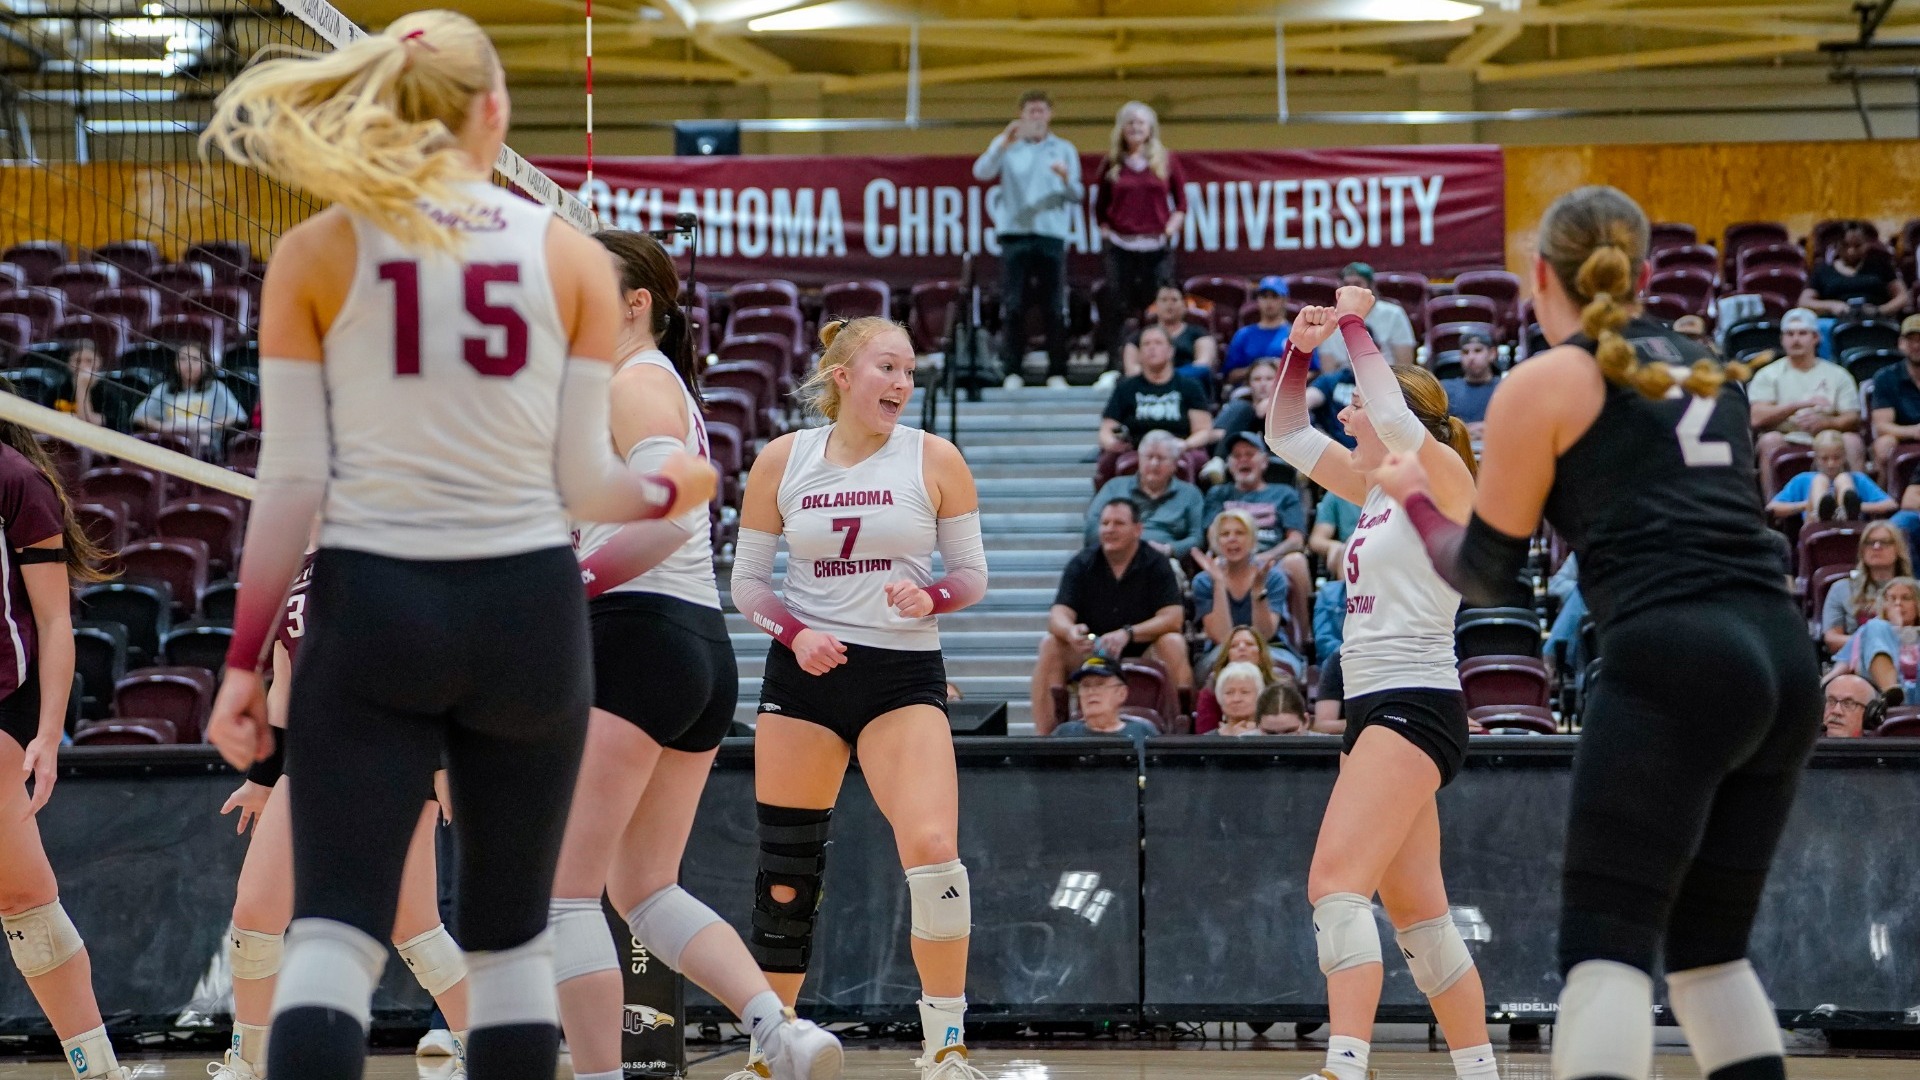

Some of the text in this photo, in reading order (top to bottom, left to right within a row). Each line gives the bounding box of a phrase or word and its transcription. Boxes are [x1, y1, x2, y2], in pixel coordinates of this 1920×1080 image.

[1166, 175, 1444, 251] NIVERSITY
[378, 261, 528, 377] 15
[1665, 365, 1734, 467] 2
[801, 490, 894, 510] OKLAHOMA
[832, 517, 861, 560] 7
[814, 559, 892, 578] CHRISTIAN
[1346, 537, 1366, 584] 5
[286, 594, 306, 639] 3
[1347, 596, 1376, 614] STIAN
[1508, 1003, 1562, 1012] SIDELIN
[632, 1061, 667, 1069] 556-3198
